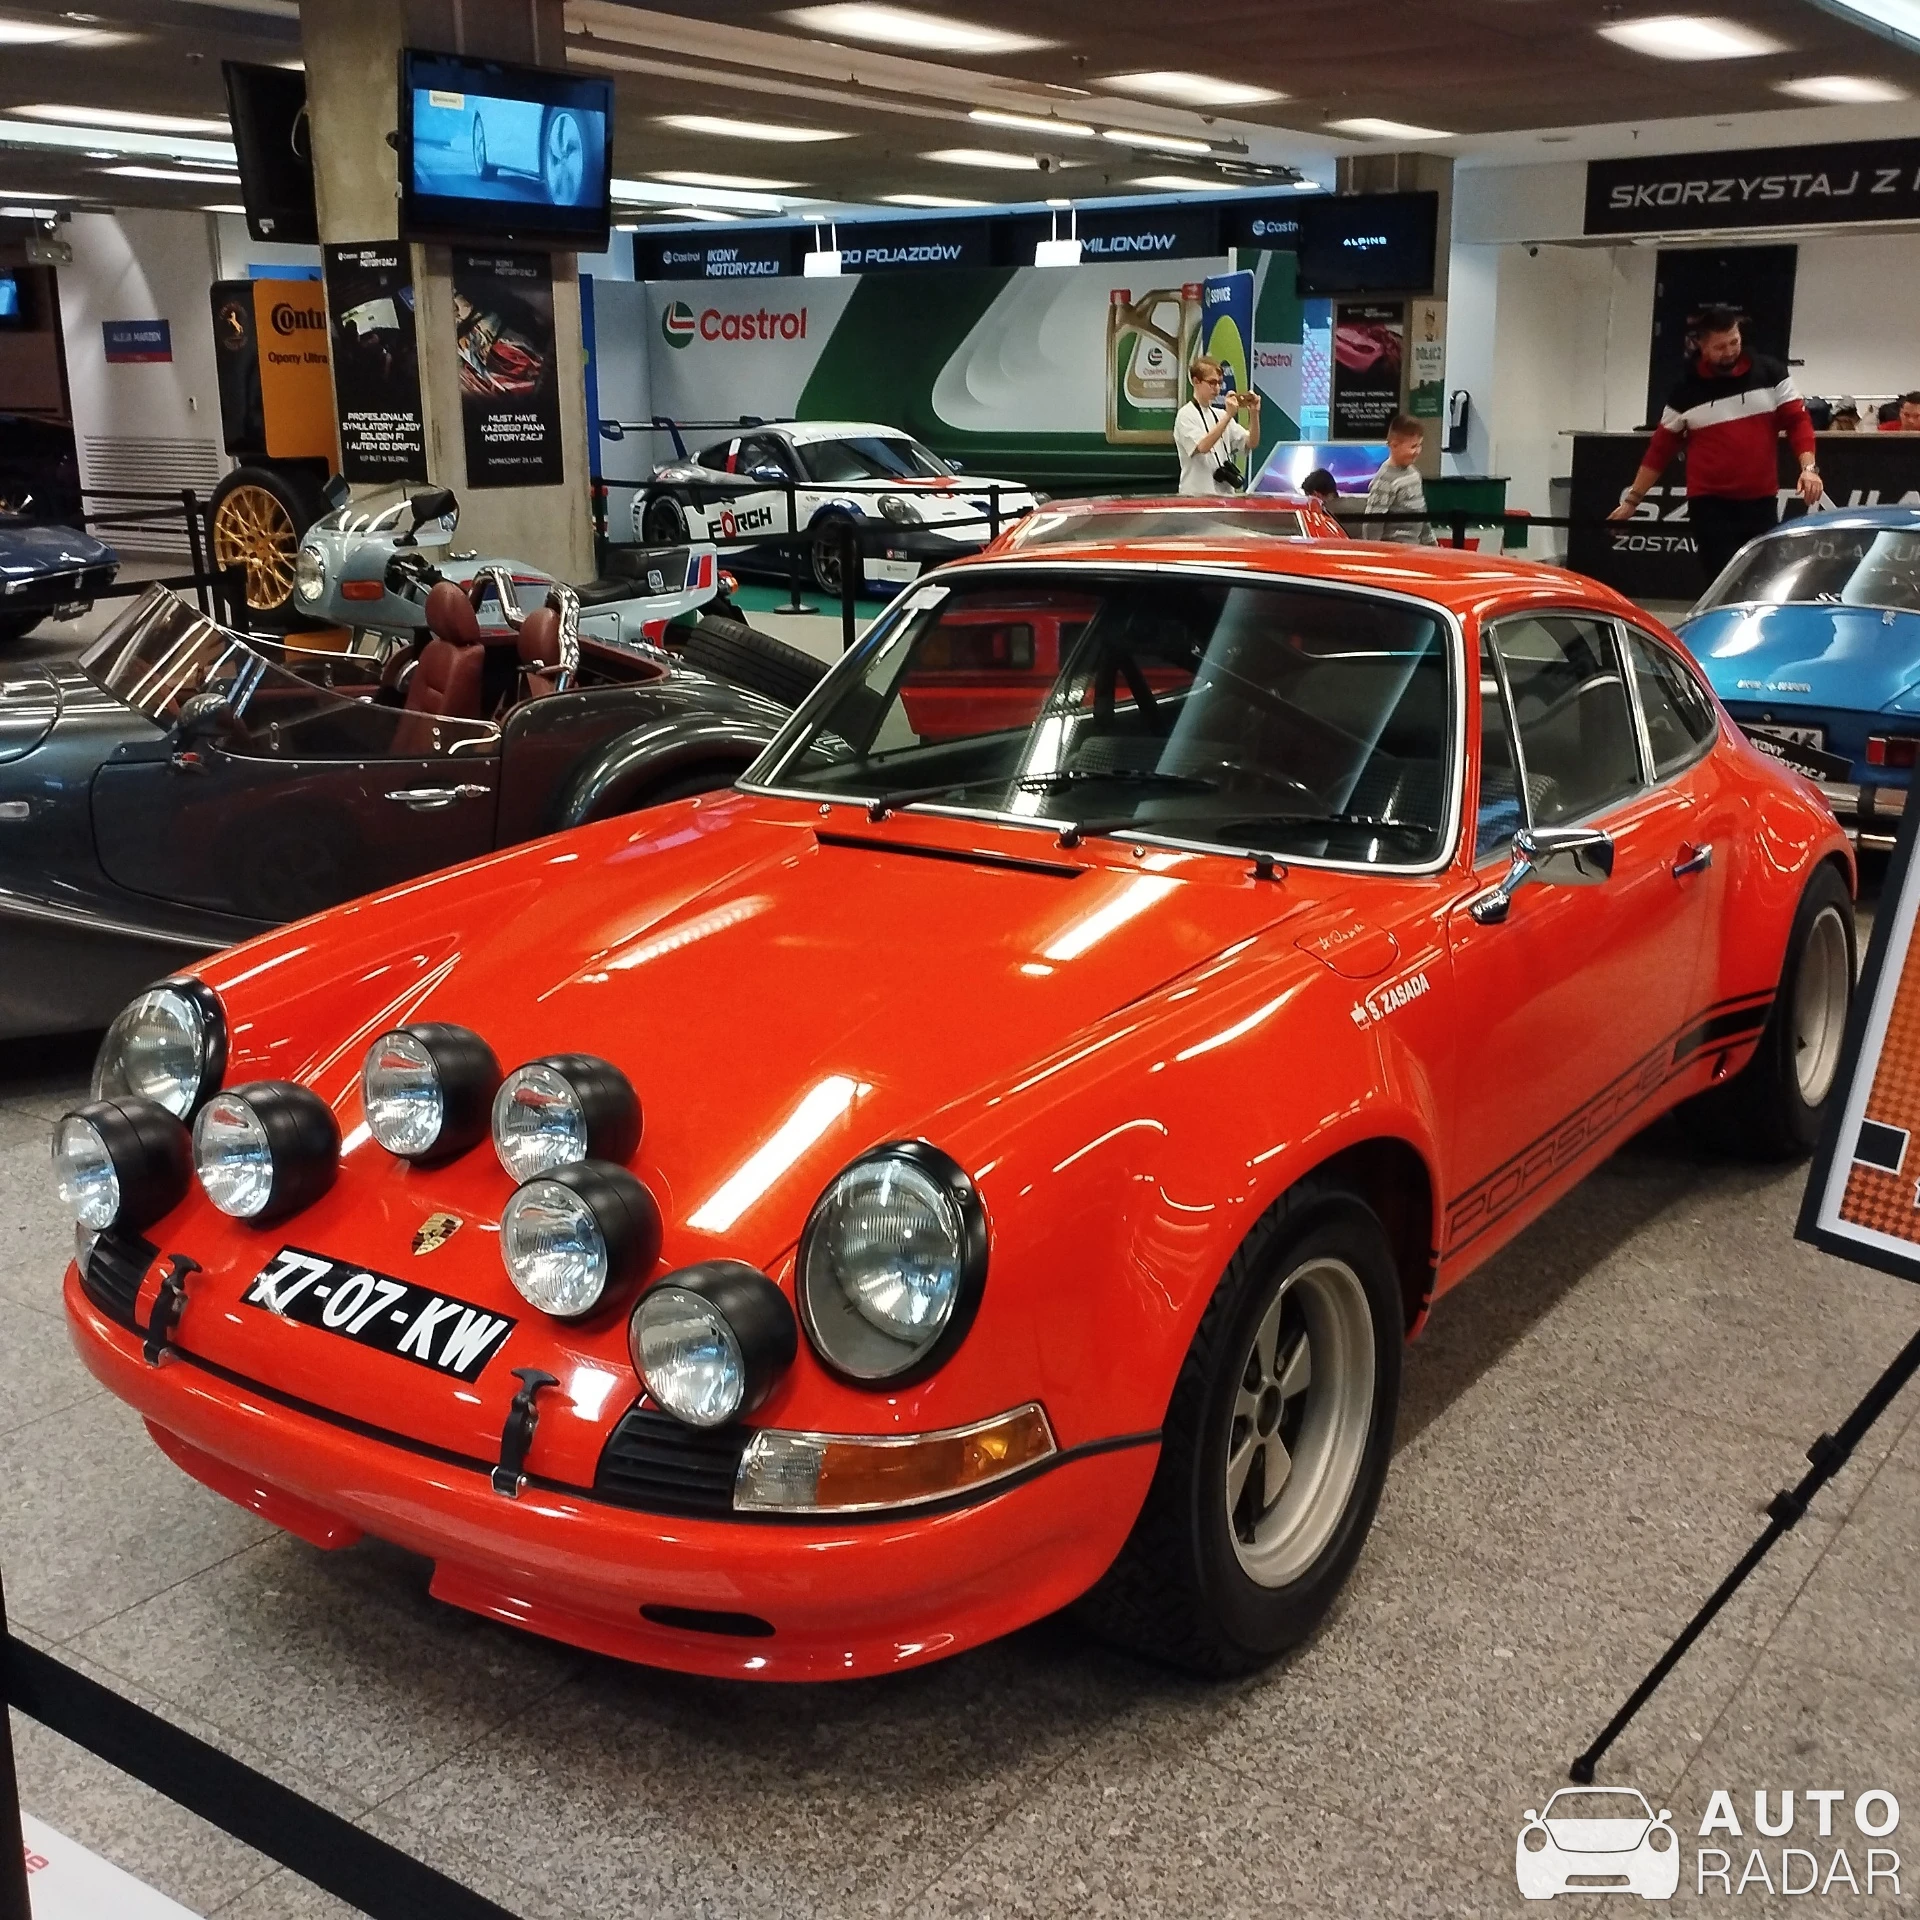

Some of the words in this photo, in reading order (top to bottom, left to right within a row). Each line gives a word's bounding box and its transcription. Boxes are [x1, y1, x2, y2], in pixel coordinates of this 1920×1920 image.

[1609, 171, 1860, 208] SKORZYSTAJ
[1871, 169, 1901, 193] Z
[672, 252, 700, 262] Castrol
[707, 249, 739, 262] IKONY
[865, 243, 962, 263] POJAZDÓW
[705, 261, 780, 276] MOTORYZACJI
[700, 307, 807, 341] Castrol
[268, 351, 301, 365] Opony
[1260, 352, 1292, 367] Castrol
[347, 412, 414, 422] PROFESJONALNE
[488, 414, 513, 423] MUST
[514, 414, 538, 422] HAVE
[342, 422, 393, 431] SYMULATORY
[523, 423, 546, 431] FANA
[484, 433, 544, 442] MOTORYZACJI
[391, 442, 420, 452] DRIFTU
[1380, 972, 1431, 1014] ZASADA
